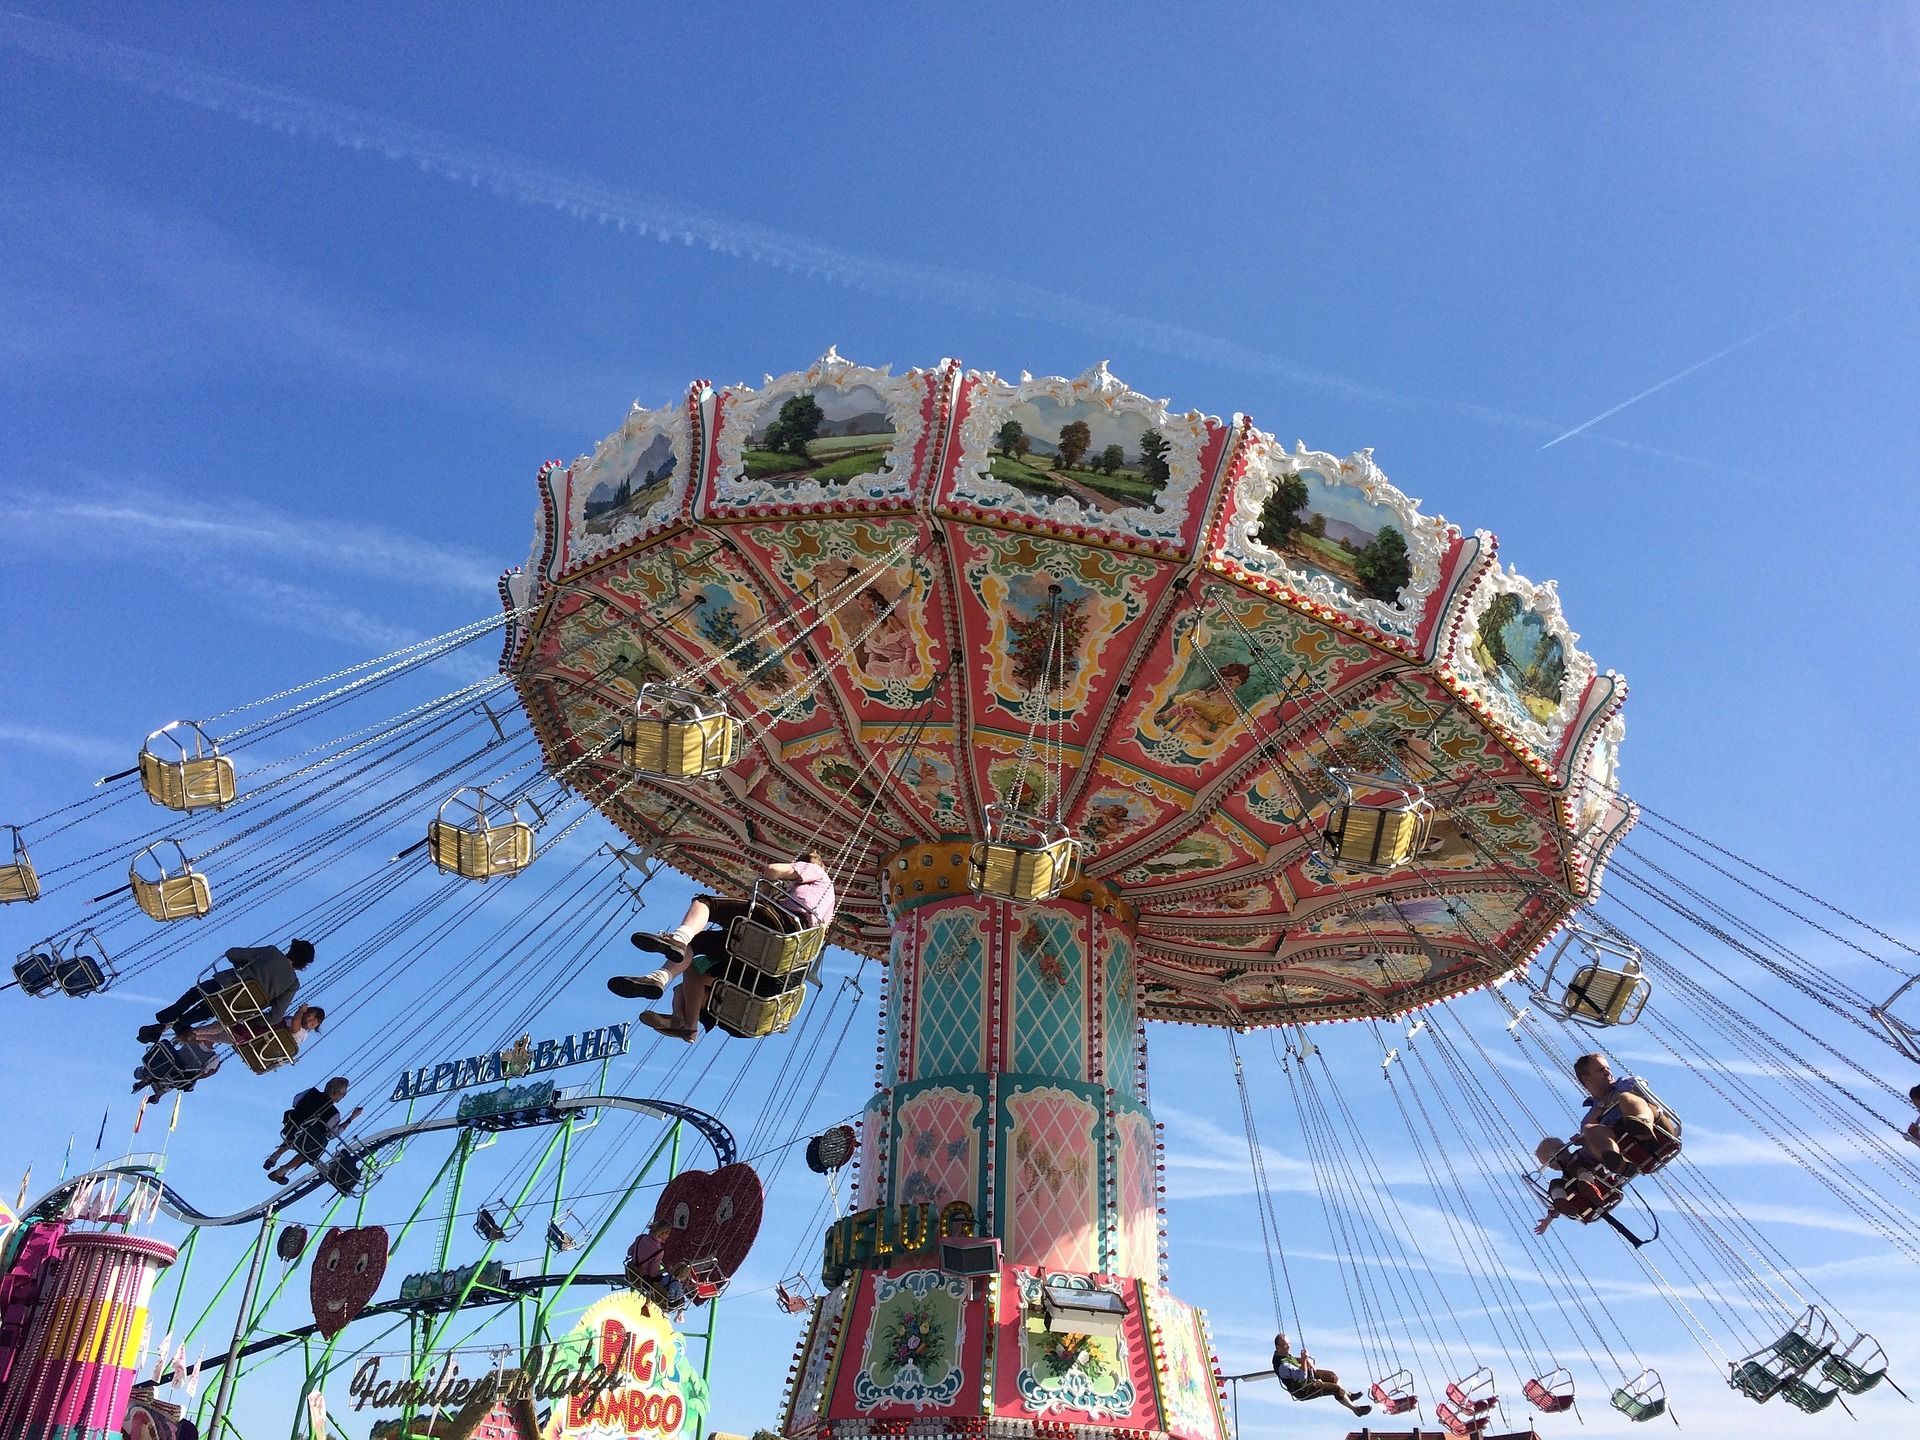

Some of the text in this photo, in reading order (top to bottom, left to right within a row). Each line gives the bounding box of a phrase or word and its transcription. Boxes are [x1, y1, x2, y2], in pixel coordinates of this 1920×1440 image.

[391, 1022, 630, 1102] ALPINA BAHN
[600, 1319, 655, 1382] BIG
[350, 1352, 499, 1411] Familien
[567, 1388, 683, 1434] BAMBOO
